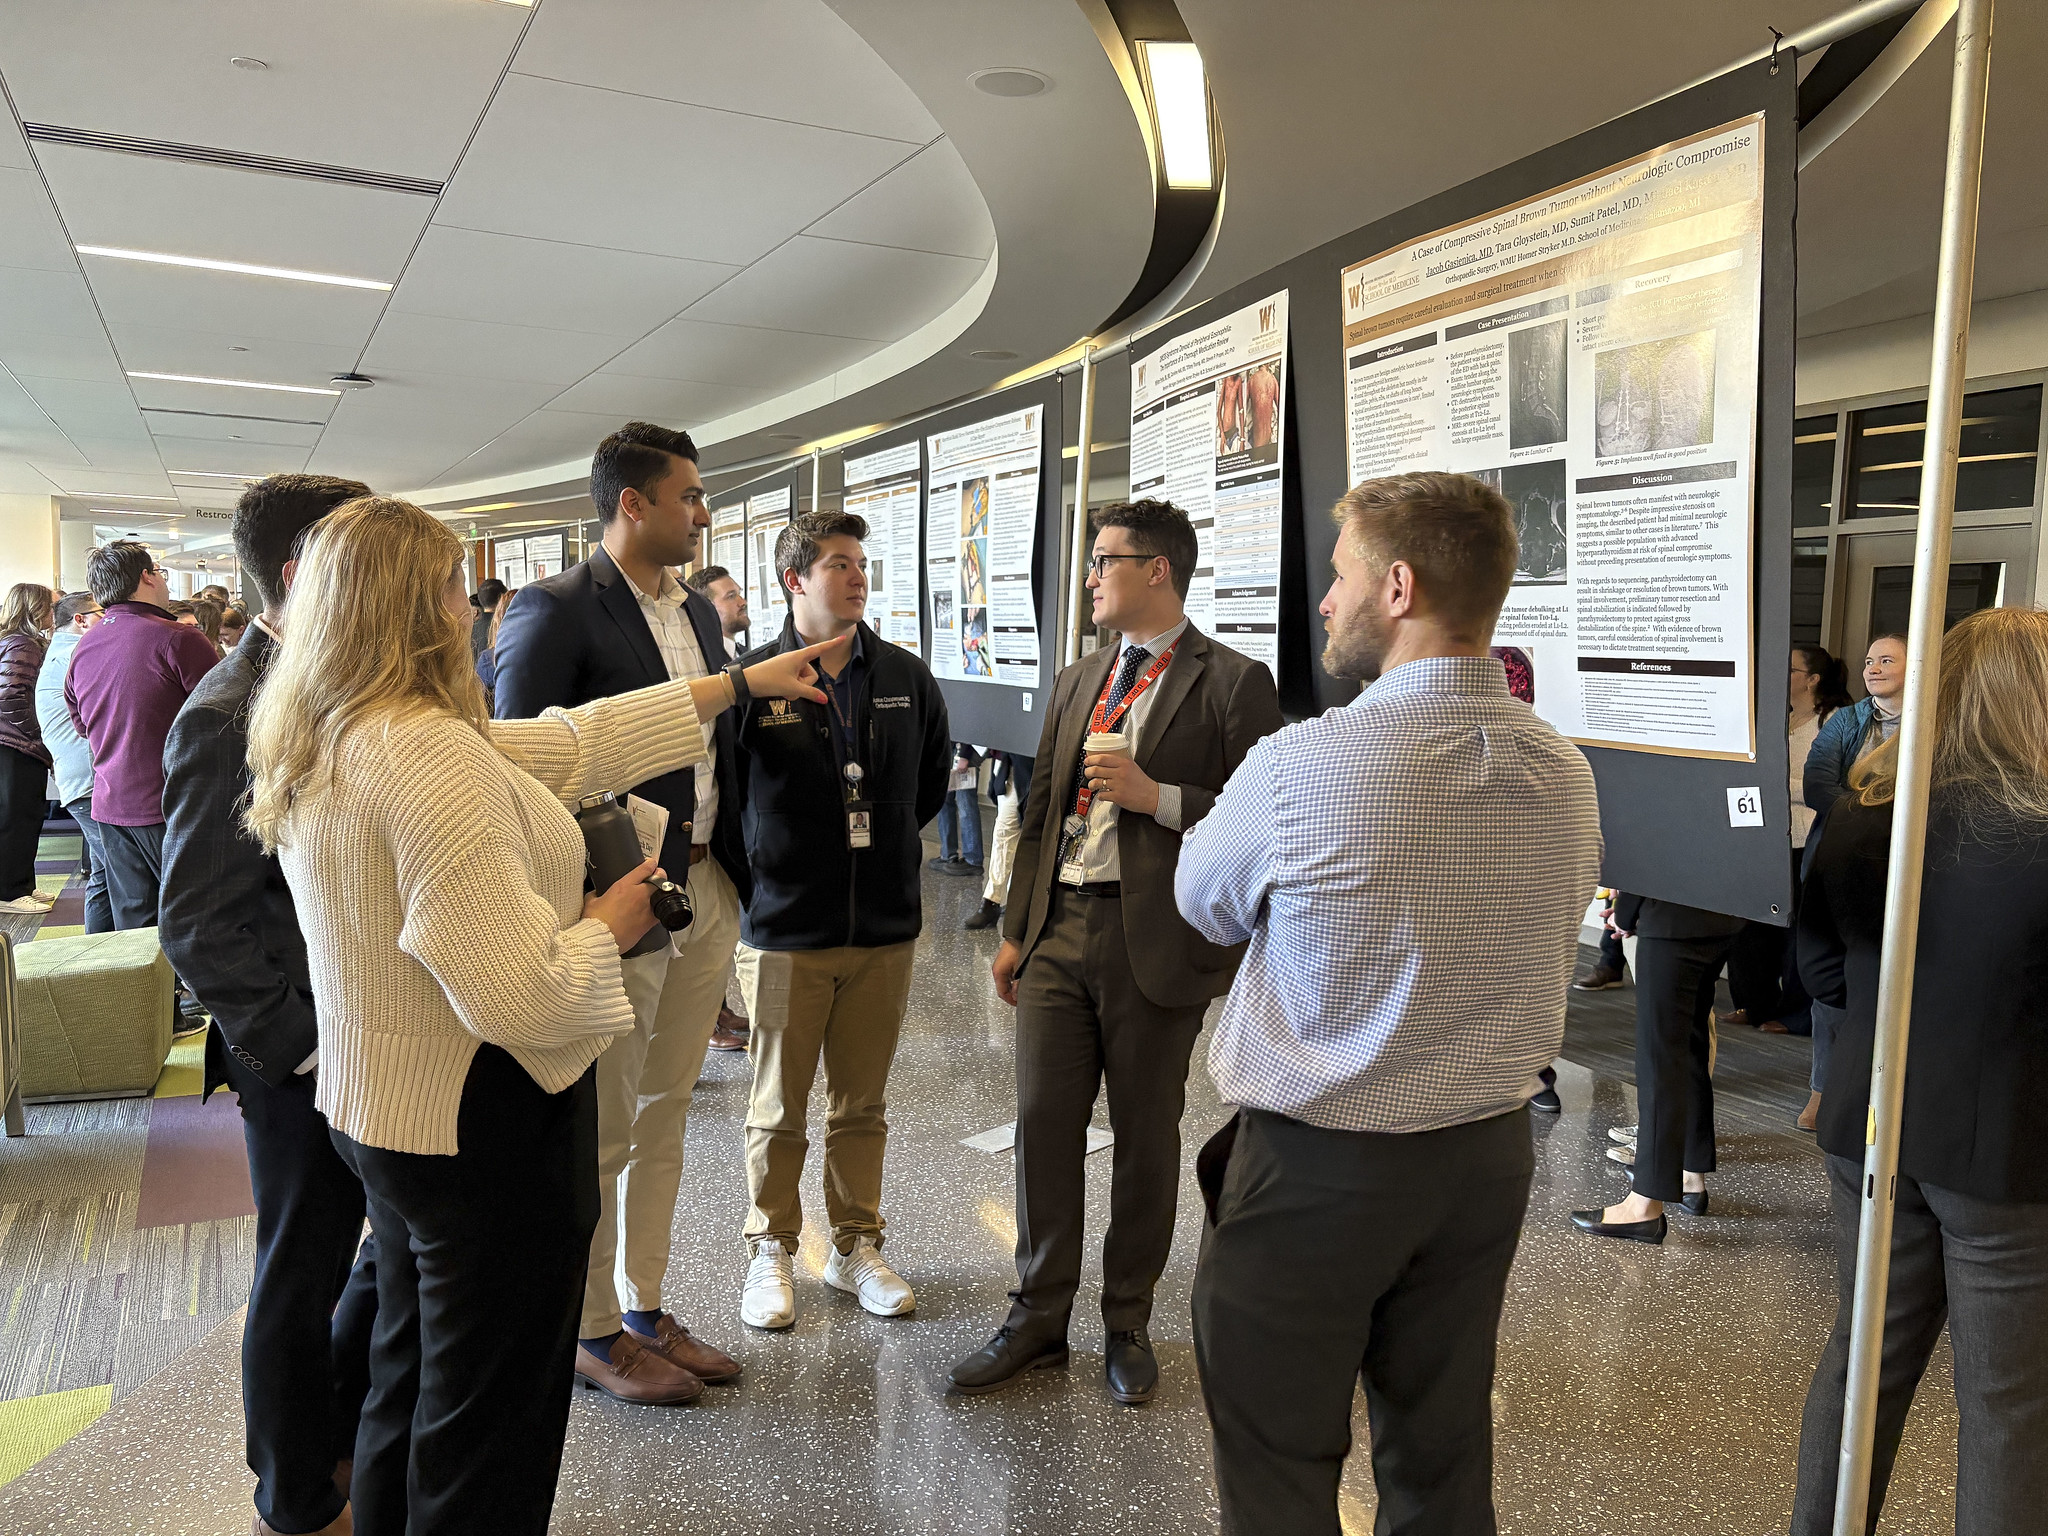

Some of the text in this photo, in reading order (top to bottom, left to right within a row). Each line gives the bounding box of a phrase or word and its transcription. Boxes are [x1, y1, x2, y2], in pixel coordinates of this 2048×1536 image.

[1411, 136, 1750, 261] A Case of Compressive Spinal Brown Tumor without Neurologic Compromise
[1425, 196, 1641, 278] Jacob Gasienica, MD, Tara Gloystein, MD, Sumit Patel, MD,
[1445, 268, 1475, 284] Orthopaedic
[1476, 262, 1498, 274] Surgery,
[1499, 254, 1516, 266] WMU
[1517, 250, 1537, 261] Homer
[1538, 242, 1559, 255] Stryker
[1577, 228, 1599, 242] School
[1600, 224, 1608, 235] of
[1392, 275, 1420, 290] MEDICINE
[1635, 274, 1672, 289] Recovery
[1349, 269, 1557, 341] Spinal brown tumors require careful evaluation and surgical treatment when
[1478, 310, 1529, 330] Case Presentation
[1377, 345, 1403, 359] Introduction
[1632, 473, 1672, 484] Discussion
[1576, 501, 1592, 511] Spinal
[1593, 500, 1610, 508] brown
[1632, 496, 1647, 504] often
[1648, 494, 1672, 503] manifest
[1673, 492, 1687, 500] with
[1688, 490, 1720, 499] neurologic
[1628, 506, 1649, 516] Despite
[1650, 503, 1681, 514] impressive
[1682, 501, 1705, 510] stenosis
[1609, 517, 1636, 526] described
[1636, 516, 1656, 525] patient
[1657, 514, 1668, 522] had
[1669, 512, 1693, 521] minimal
[1694, 510, 1727, 519] neurologic
[1605, 528, 1624, 536] similar
[1632, 526, 1648, 534] other
[1664, 524, 1670, 532] in
[1704, 520, 1718, 529] This
[1576, 540, 1598, 548] suggests
[1603, 537, 1625, 547] possible
[1626, 536, 1656, 546] population
[1657, 534, 1669, 542] with
[1670, 532, 1698, 541] advanced
[1639, 545, 1650, 553] risk
[1650, 544, 1657, 553] of
[1657, 544, 1674, 554] spinal
[1675, 542, 1712, 552] compromise
[1597, 557, 1624, 566] preceding
[1624, 555, 1658, 565] presentation
[1659, 554, 1666, 562] of
[1666, 553, 1697, 562] neurologic
[1698, 553, 1732, 562] symptoms.
[1590, 576, 1610, 585] regards
[1576, 586, 1591, 594] result
[1598, 586, 1625, 594] shrinkage
[1661, 584, 1668, 592] of
[1668, 584, 1686, 592] brown
[1712, 582, 1728, 590] With
[1576, 596, 1592, 605] spinal
[1593, 595, 1627, 603] involvement,
[1628, 595, 1660, 604] preliminary
[1679, 594, 1707, 602] resection
[1708, 593, 1720, 601] and
[1576, 605, 1592, 614] spinal
[1626, 604, 1631, 612] is
[1632, 604, 1657, 612] indicated
[1658, 604, 1682, 612] followed
[1683, 604, 1691, 613] by
[1653, 614, 1674, 623] against
[1674, 616, 1690, 624] gross
[1652, 624, 1666, 632] With
[1667, 624, 1693, 632] evidence
[1693, 624, 1701, 632] of
[1701, 624, 1721, 632] brown
[1597, 633, 1615, 641] careful
[1653, 634, 1660, 642] of
[1660, 634, 1678, 643] spinal
[1679, 634, 1716, 642] involvement
[1717, 634, 1723, 642] is
[1608, 643, 1627, 651] dictate
[1631, 662, 1671, 672] References
[1737, 797, 1757, 814] 61
